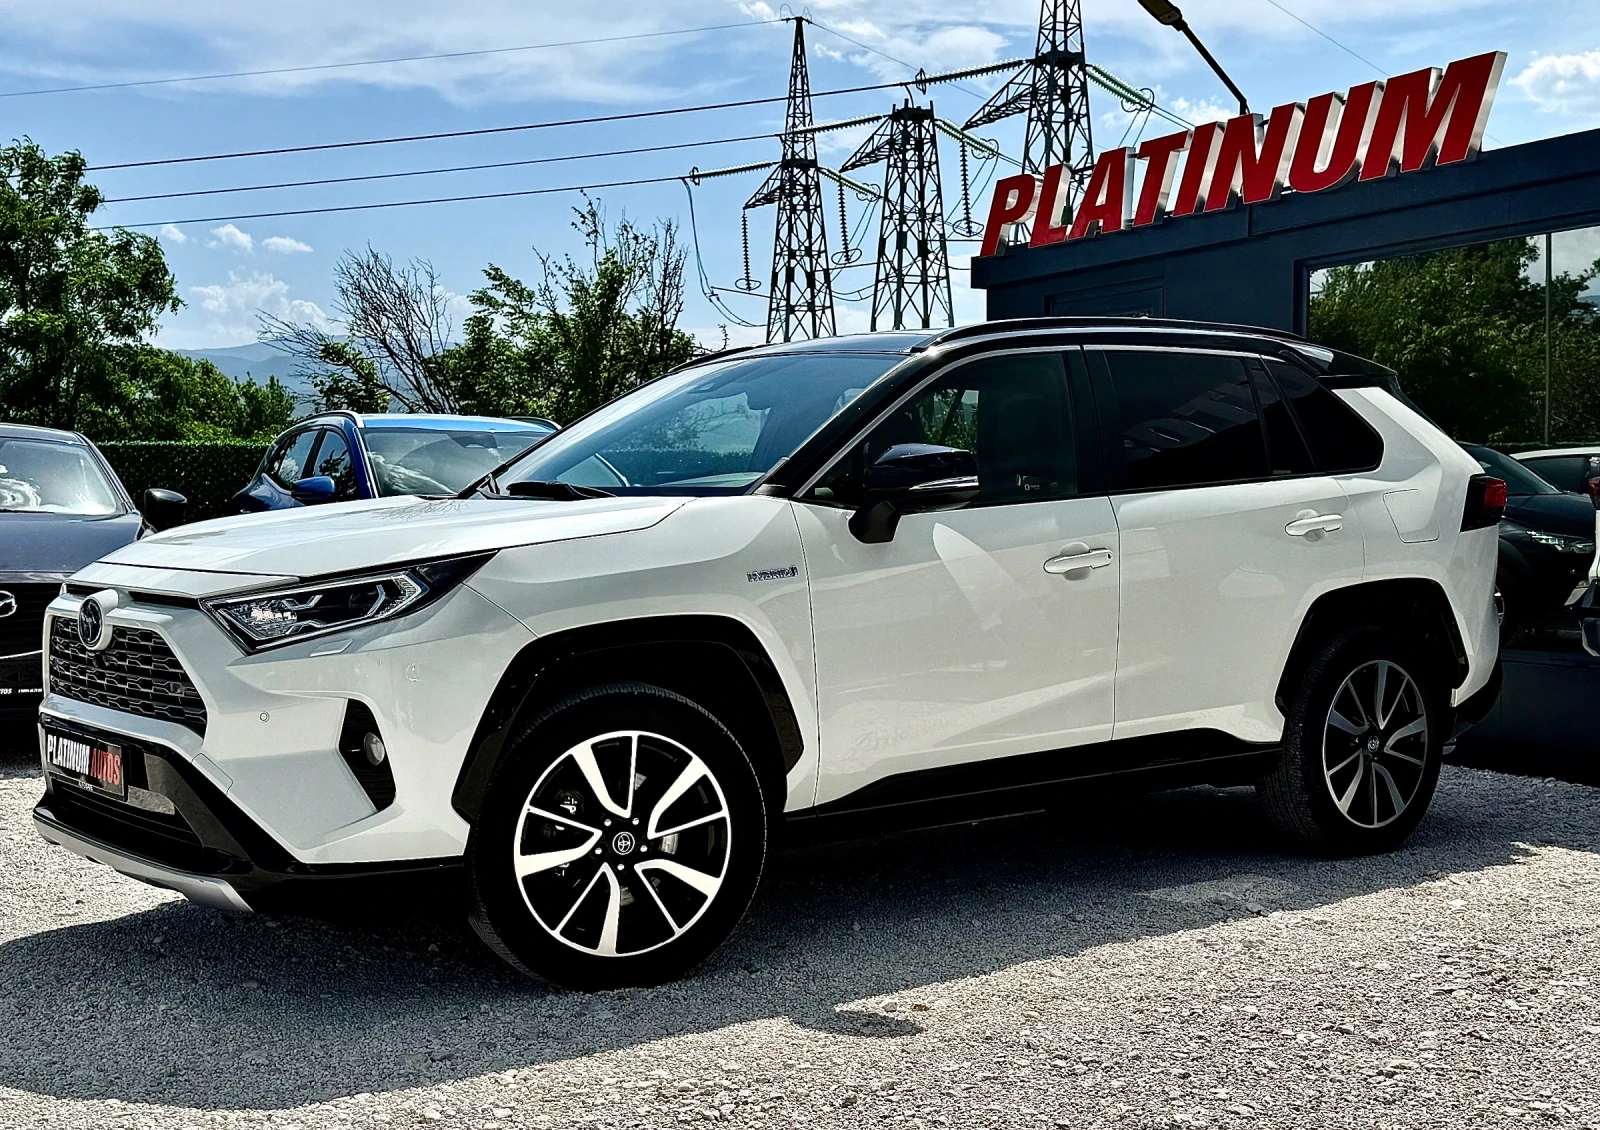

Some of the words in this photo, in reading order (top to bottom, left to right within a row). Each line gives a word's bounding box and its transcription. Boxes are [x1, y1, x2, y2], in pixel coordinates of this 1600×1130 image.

[980, 50, 1507, 257] PLATINUM
[47, 734, 91, 776] PLATINUM
[90, 748, 120, 786] AUTOS
